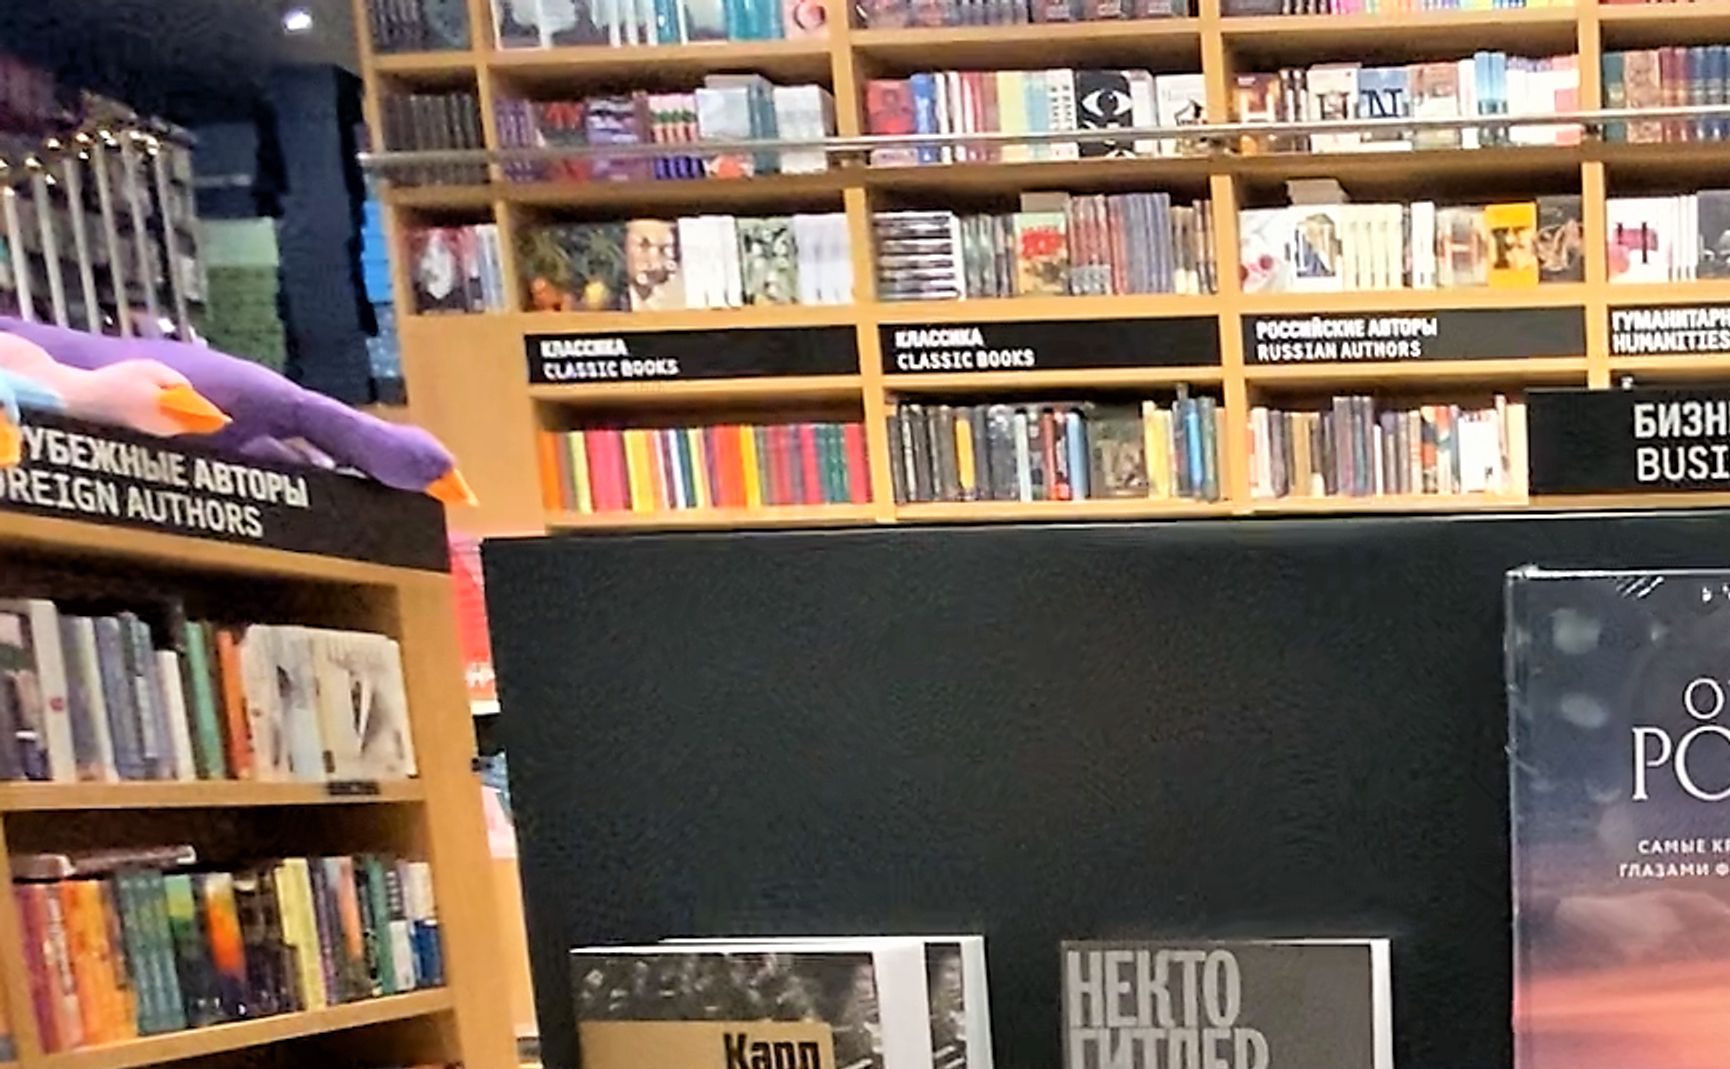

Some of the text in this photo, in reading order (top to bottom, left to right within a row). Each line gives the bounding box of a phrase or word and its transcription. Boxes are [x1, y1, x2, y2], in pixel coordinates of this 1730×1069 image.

[894, 327, 985, 348] КЛАССИКА
[1256, 315, 1438, 340] РОССИЙСКИЕ АВТОРЫ
[896, 348, 1036, 371] CLASSIC BOOKS
[1256, 340, 1422, 361] RUSSIAN AUTHORS
[543, 358, 680, 381] CLASSIC BOOKS
[21, 424, 310, 508] УБЕЖНЫЕ АВТОРЫ
[0, 467, 264, 538] REIGN AUTHORS
[1637, 838, 1707, 855] САМЫЕ
[1618, 863, 1710, 879] ГЛАЗАМИ
[1066, 948, 1242, 1029] НЕКТО
